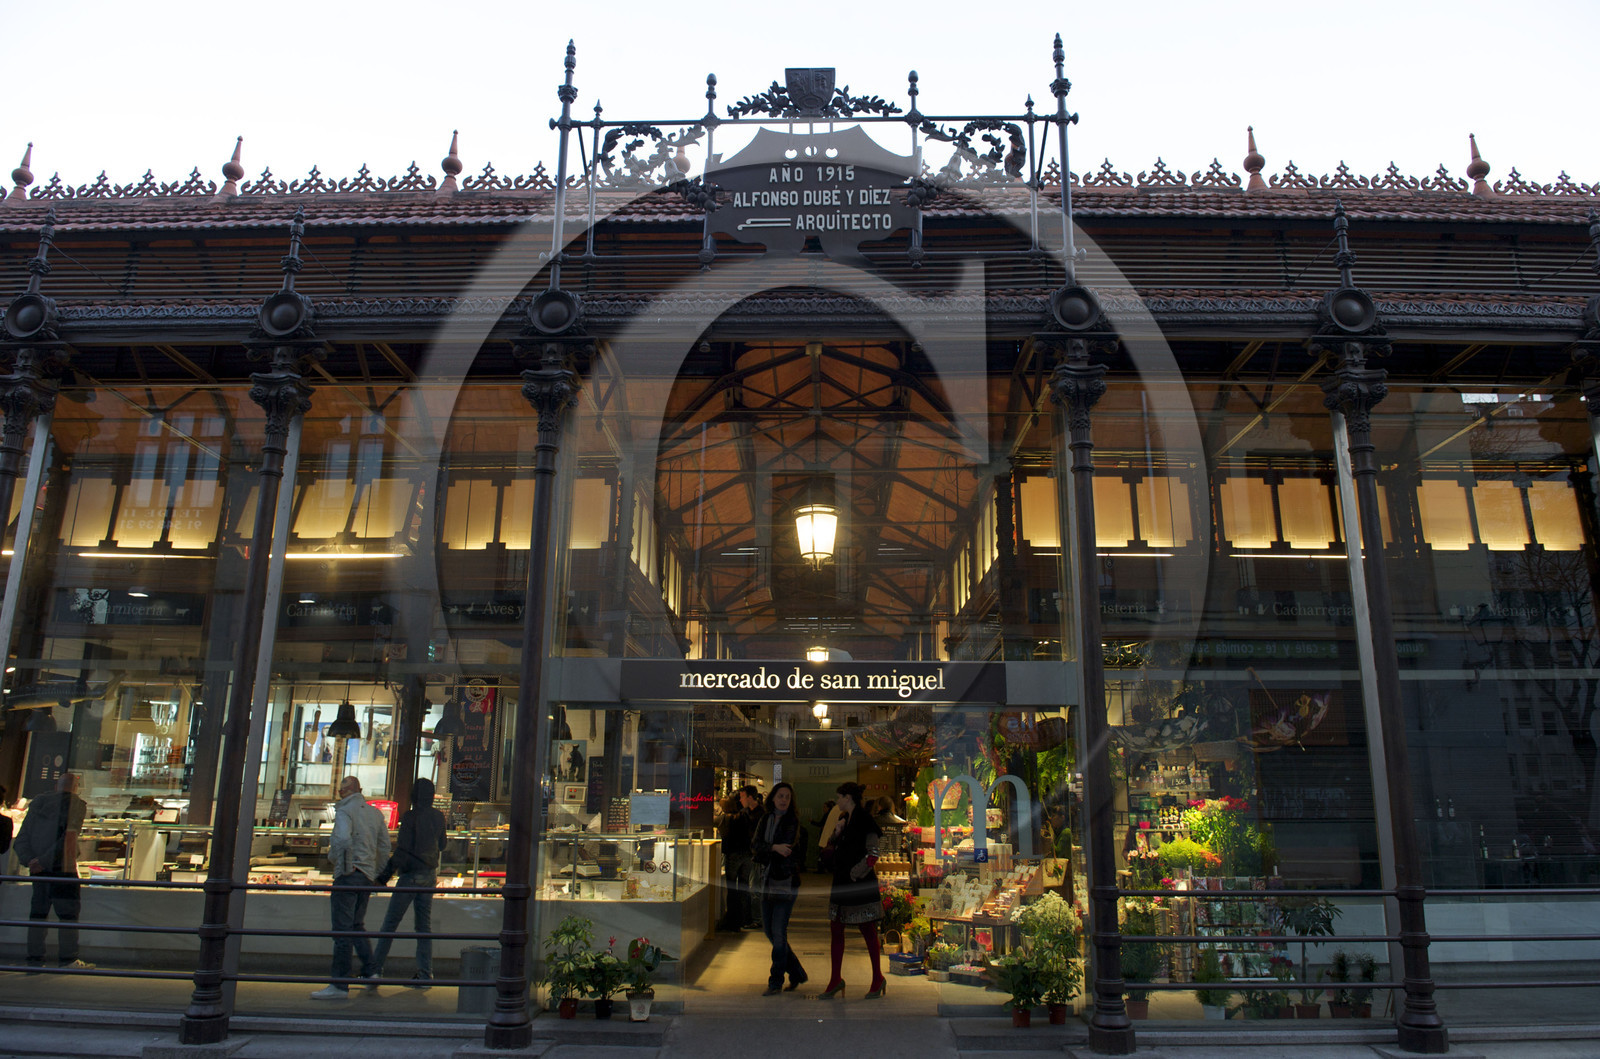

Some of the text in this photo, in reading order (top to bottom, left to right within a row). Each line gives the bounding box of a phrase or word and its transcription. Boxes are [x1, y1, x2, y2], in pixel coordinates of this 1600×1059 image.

[769, 163, 855, 183] AÑO 1915
[733, 190, 799, 208] ALFONSO
[803, 185, 841, 206] DUBÉ
[845, 189, 855, 205] Y
[482, 600, 525, 619] Aves y
[679, 667, 945, 698] mercado de san miguel
